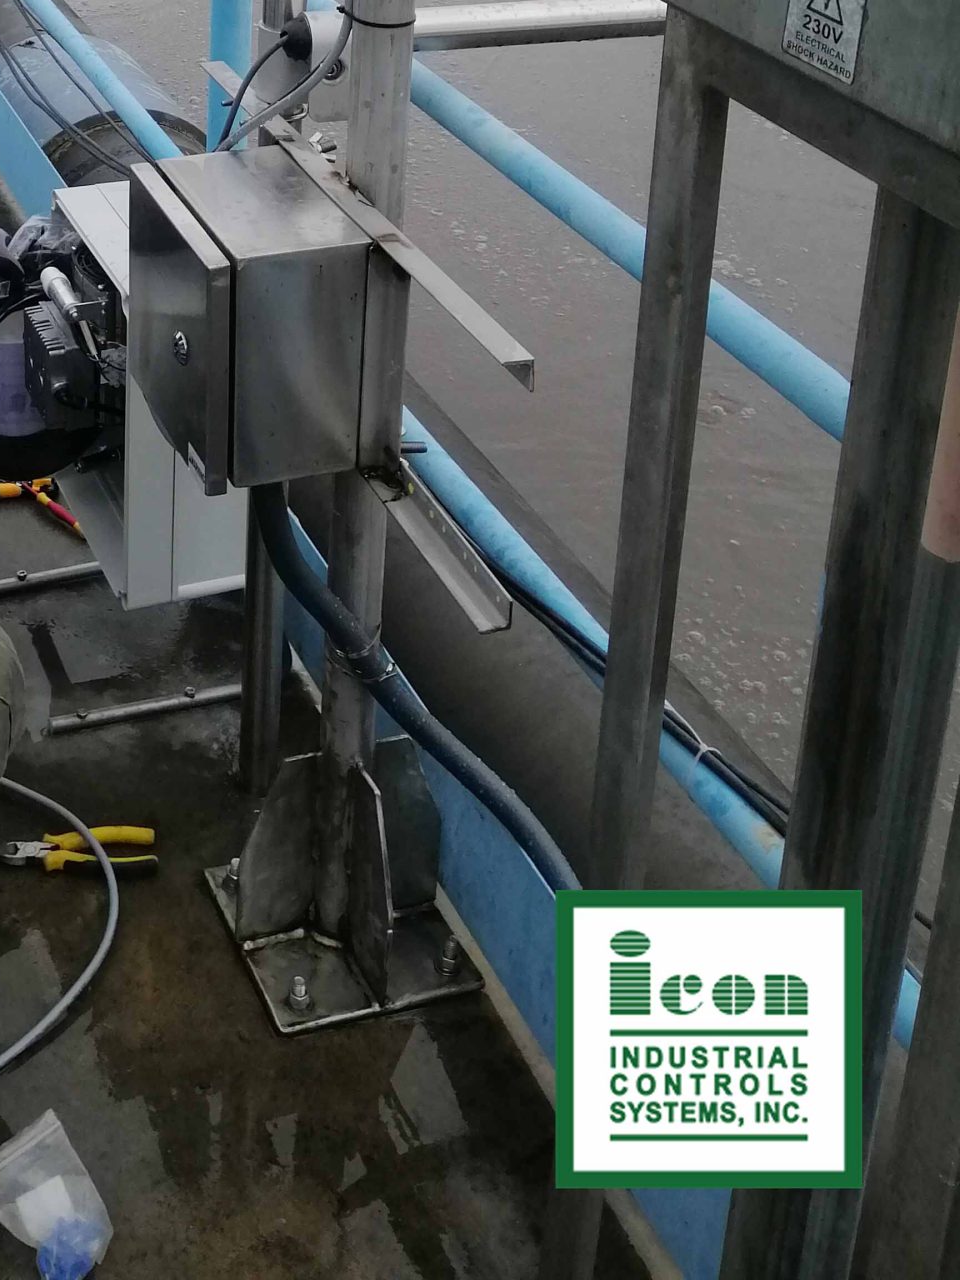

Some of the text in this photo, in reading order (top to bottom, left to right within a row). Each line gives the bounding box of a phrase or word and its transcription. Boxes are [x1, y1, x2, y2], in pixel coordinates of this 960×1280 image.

[802, 14, 844, 45] 230V
[786, 39, 851, 80] SHOCK HAZARD
[795, 30, 846, 63] ELECTRICAL
